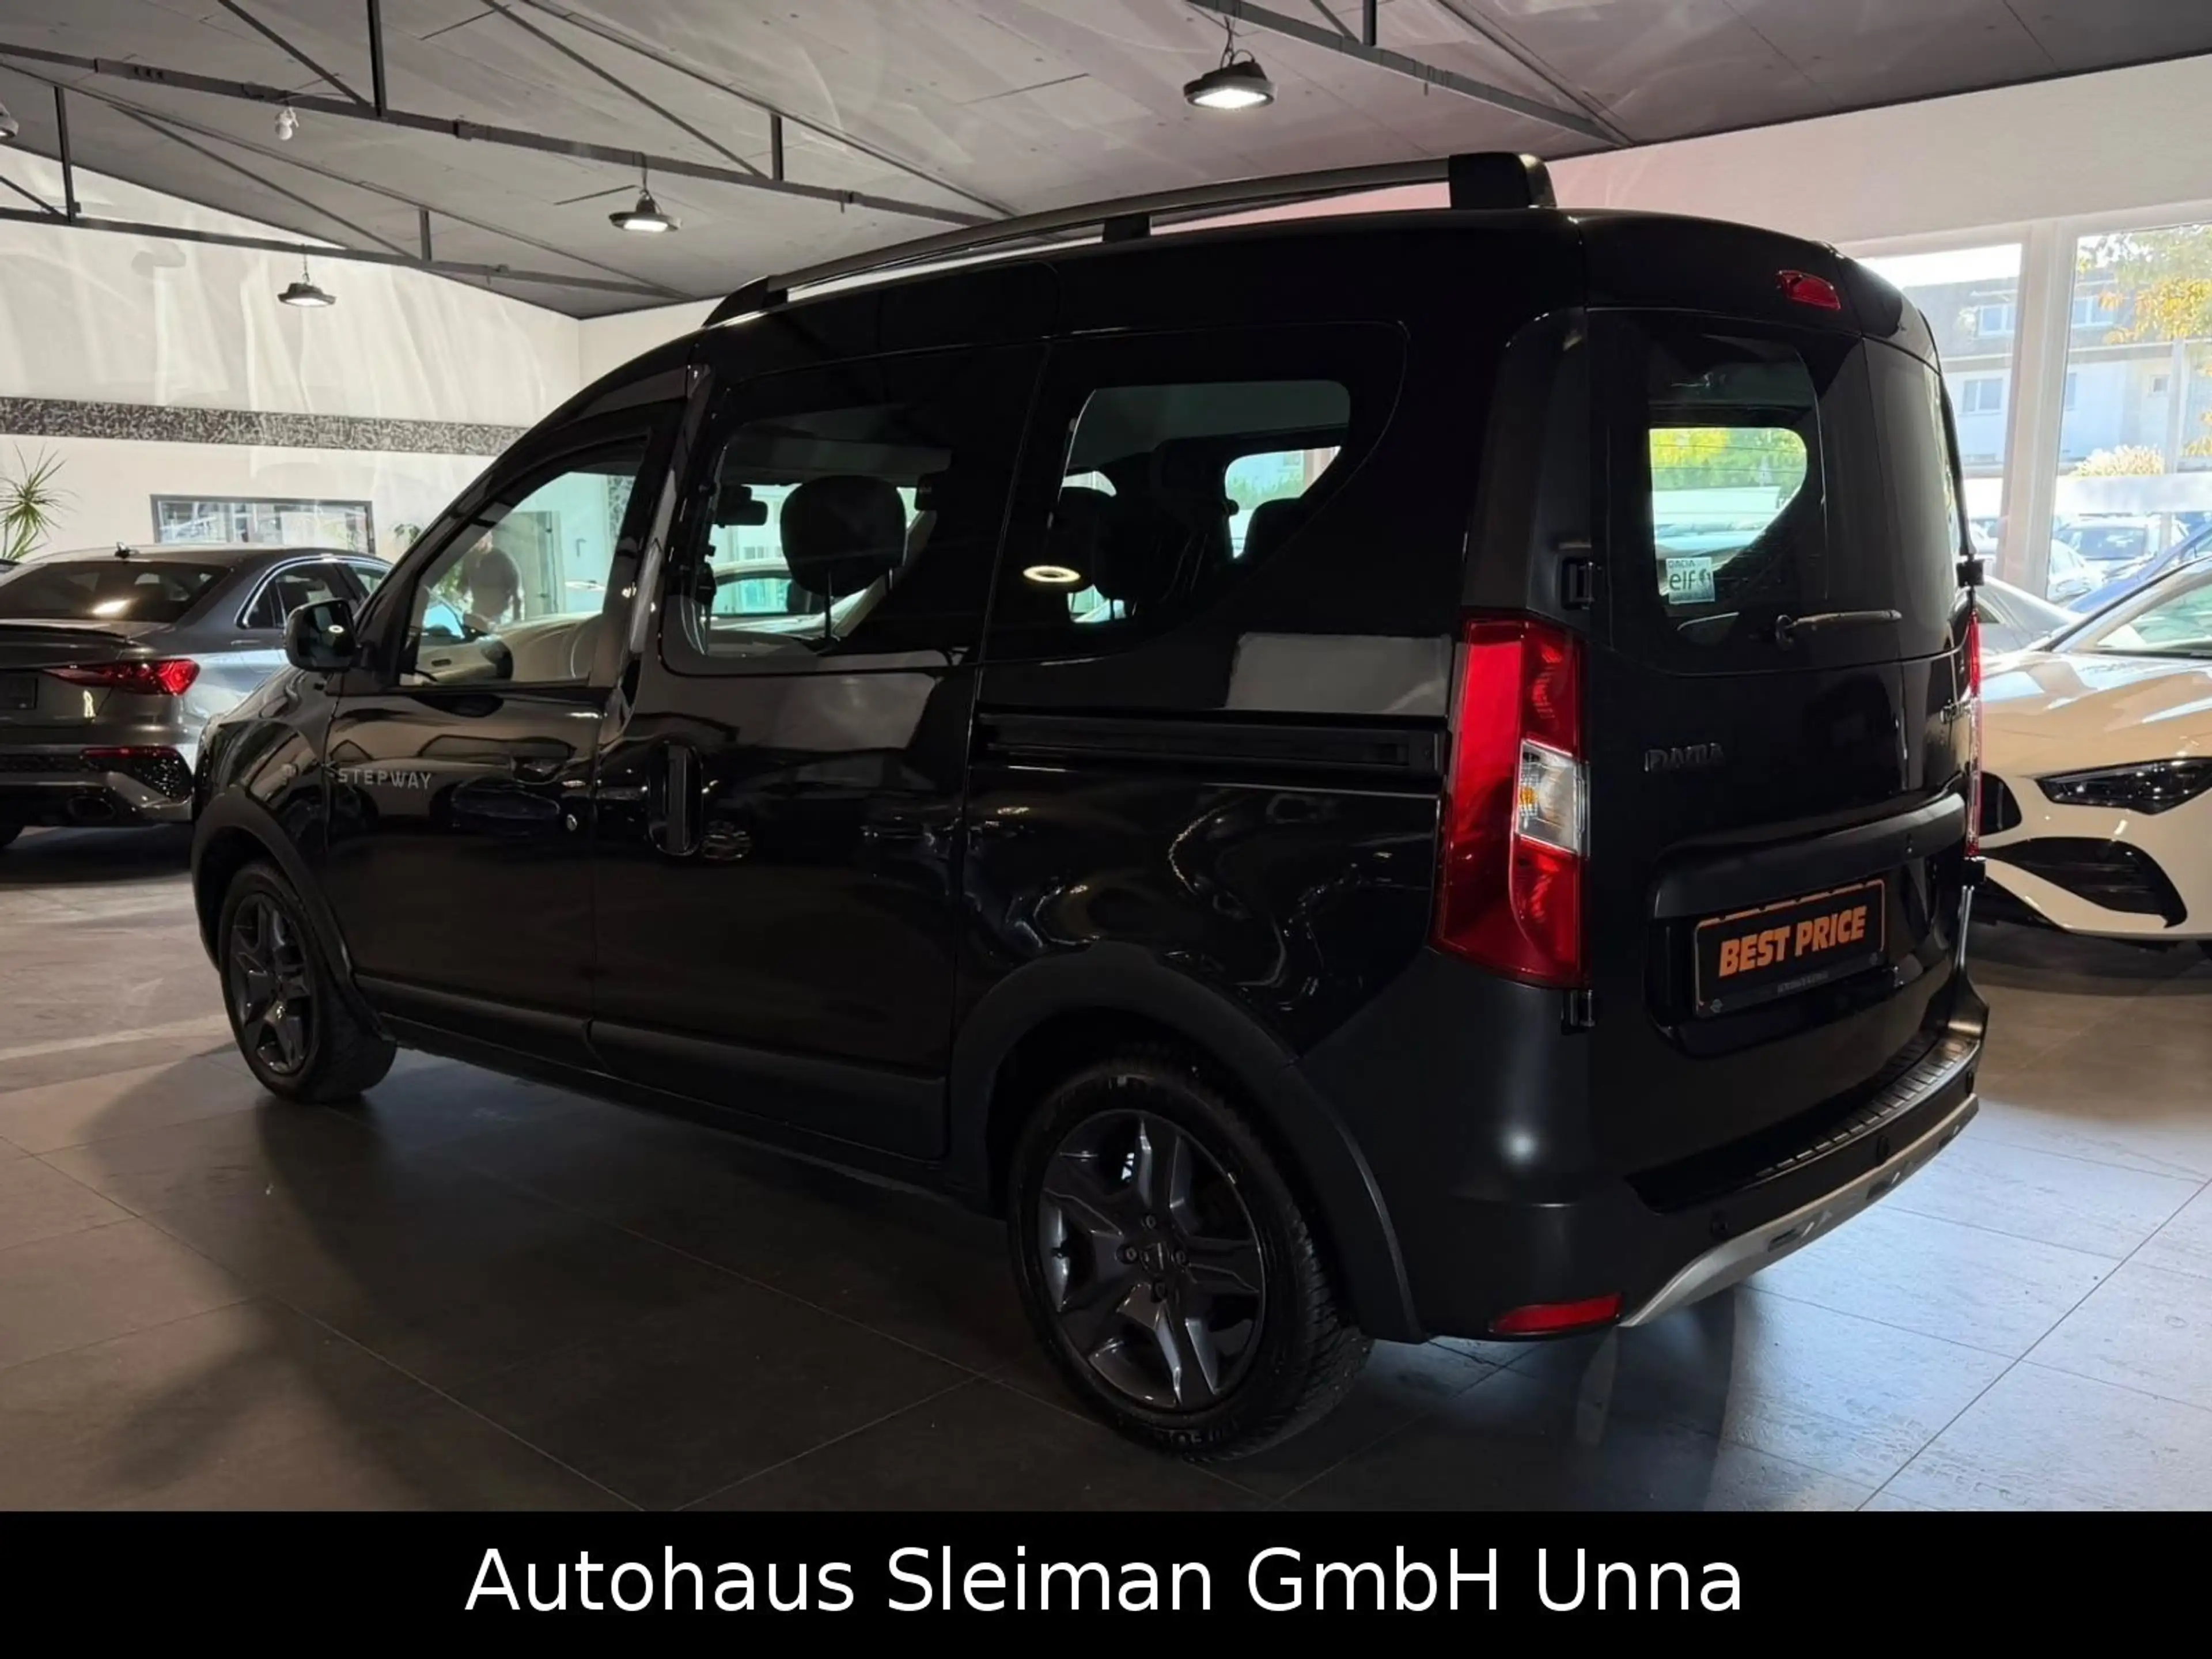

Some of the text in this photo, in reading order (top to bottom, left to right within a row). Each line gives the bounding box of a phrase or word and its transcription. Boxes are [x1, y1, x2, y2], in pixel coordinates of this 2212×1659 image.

[1670, 570, 1695, 590] elf
[338, 768, 431, 790] STEPWAY
[1719, 906, 1867, 978] BEST PRICE
